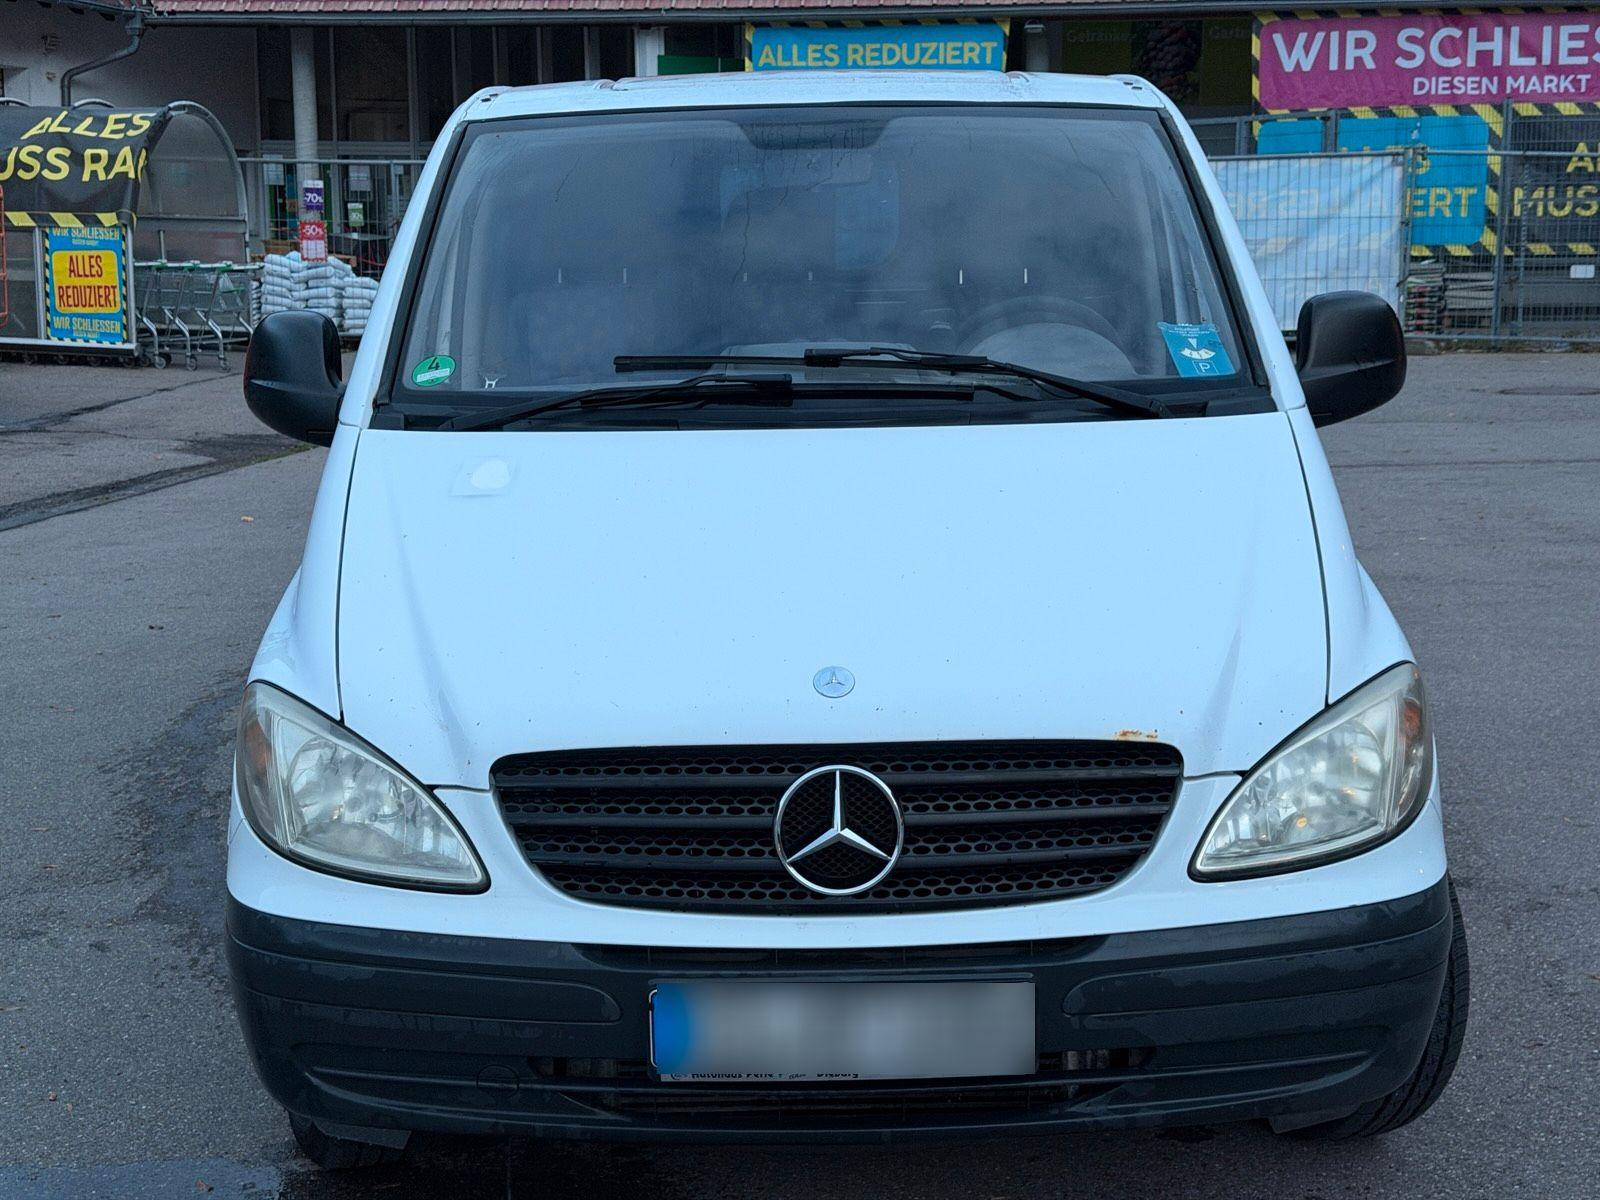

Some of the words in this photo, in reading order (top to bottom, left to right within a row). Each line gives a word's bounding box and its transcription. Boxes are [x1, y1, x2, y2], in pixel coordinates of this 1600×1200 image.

[758, 43, 840, 67] ALLES
[847, 41, 998, 66] REDUZIERT
[1272, 30, 1377, 73] WIR
[1395, 24, 1600, 69] SCHLIE
[1413, 76, 1498, 95] DIESEN
[1505, 74, 1591, 94] MARKT
[20, 110, 158, 140] ALLES
[82, 145, 148, 183] RA
[1566, 142, 1600, 173] A
[68, 255, 103, 278] ALLES
[57, 285, 118, 308] REDUZIERT
[53, 316, 71, 330] WIR
[72, 317, 120, 334] SCHLIESSEN
[428, 357, 441, 370] 4
[1199, 362, 1210, 373] P
